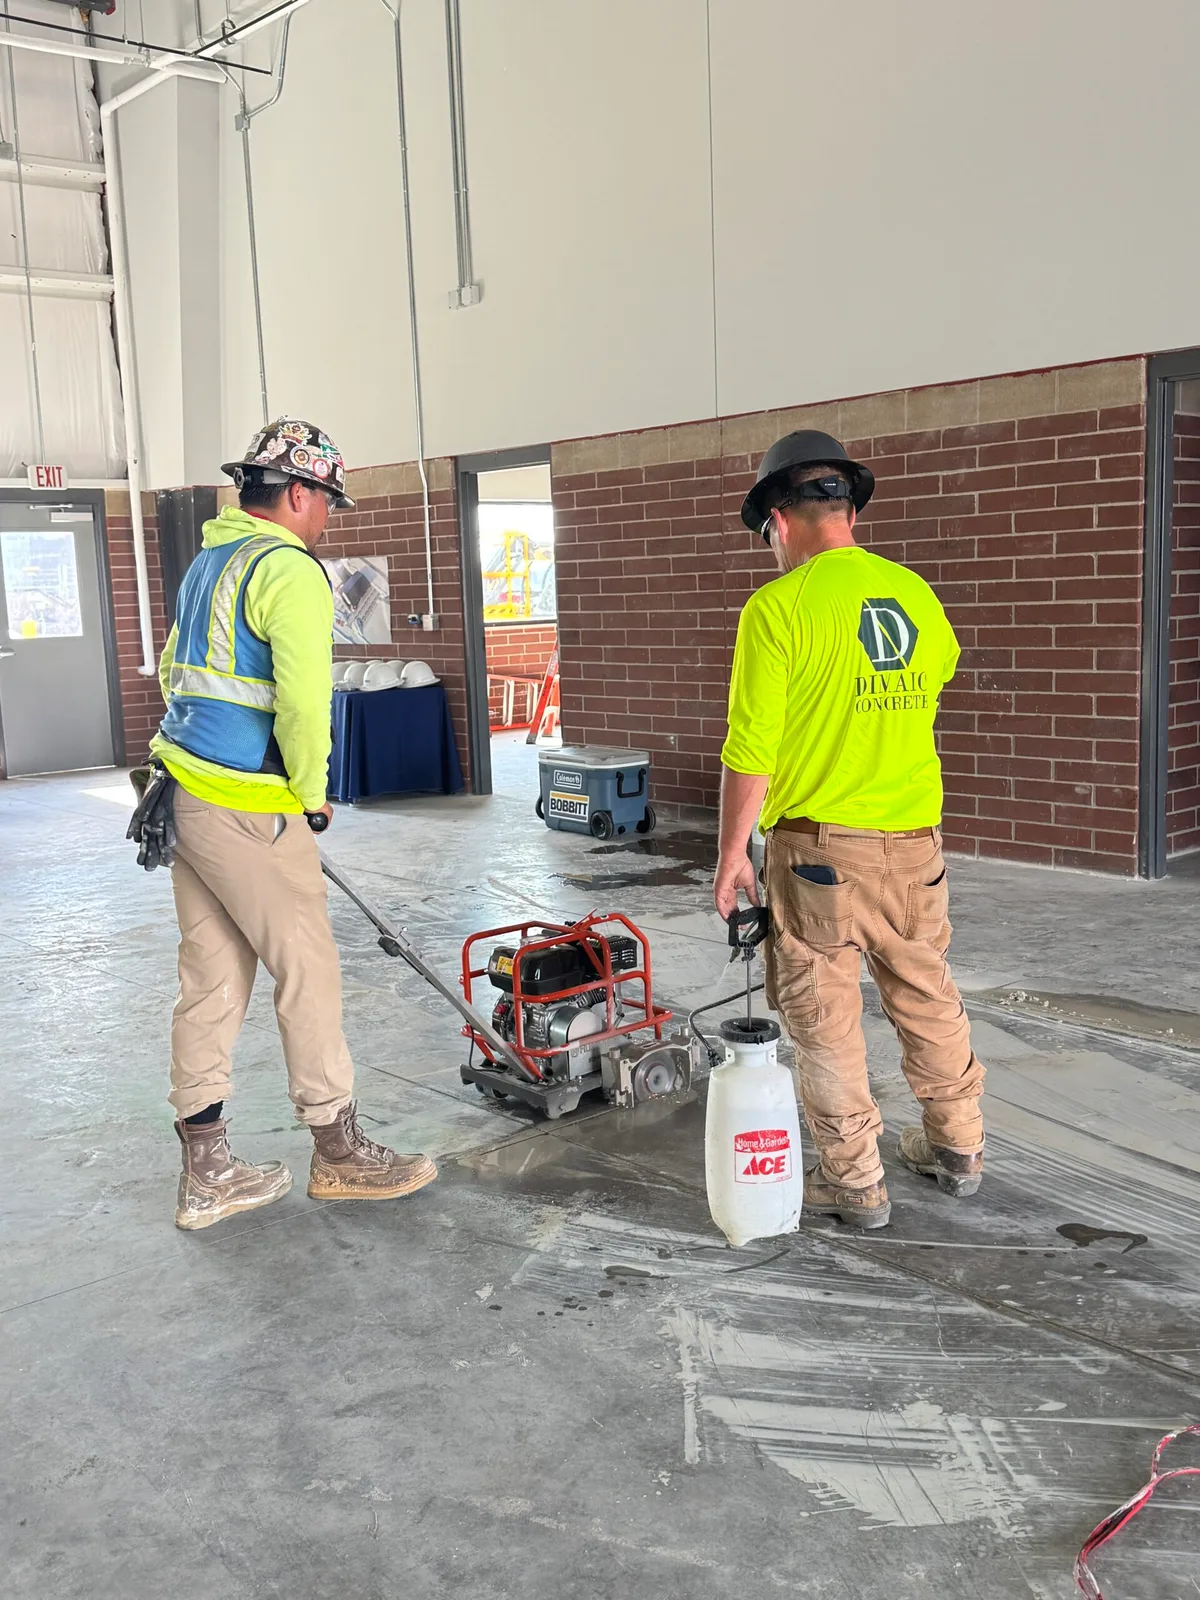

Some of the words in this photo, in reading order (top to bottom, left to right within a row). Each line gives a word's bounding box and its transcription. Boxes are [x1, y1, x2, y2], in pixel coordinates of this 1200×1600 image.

[36, 466, 63, 487] EXIT
[855, 695, 929, 714] CONCRETE
[556, 772, 575, 784] Coleman
[550, 798, 588, 815] BOBBITT
[738, 1137, 759, 1148] Home
[766, 1135, 789, 1147] Garden
[742, 1155, 786, 1175] ACE
